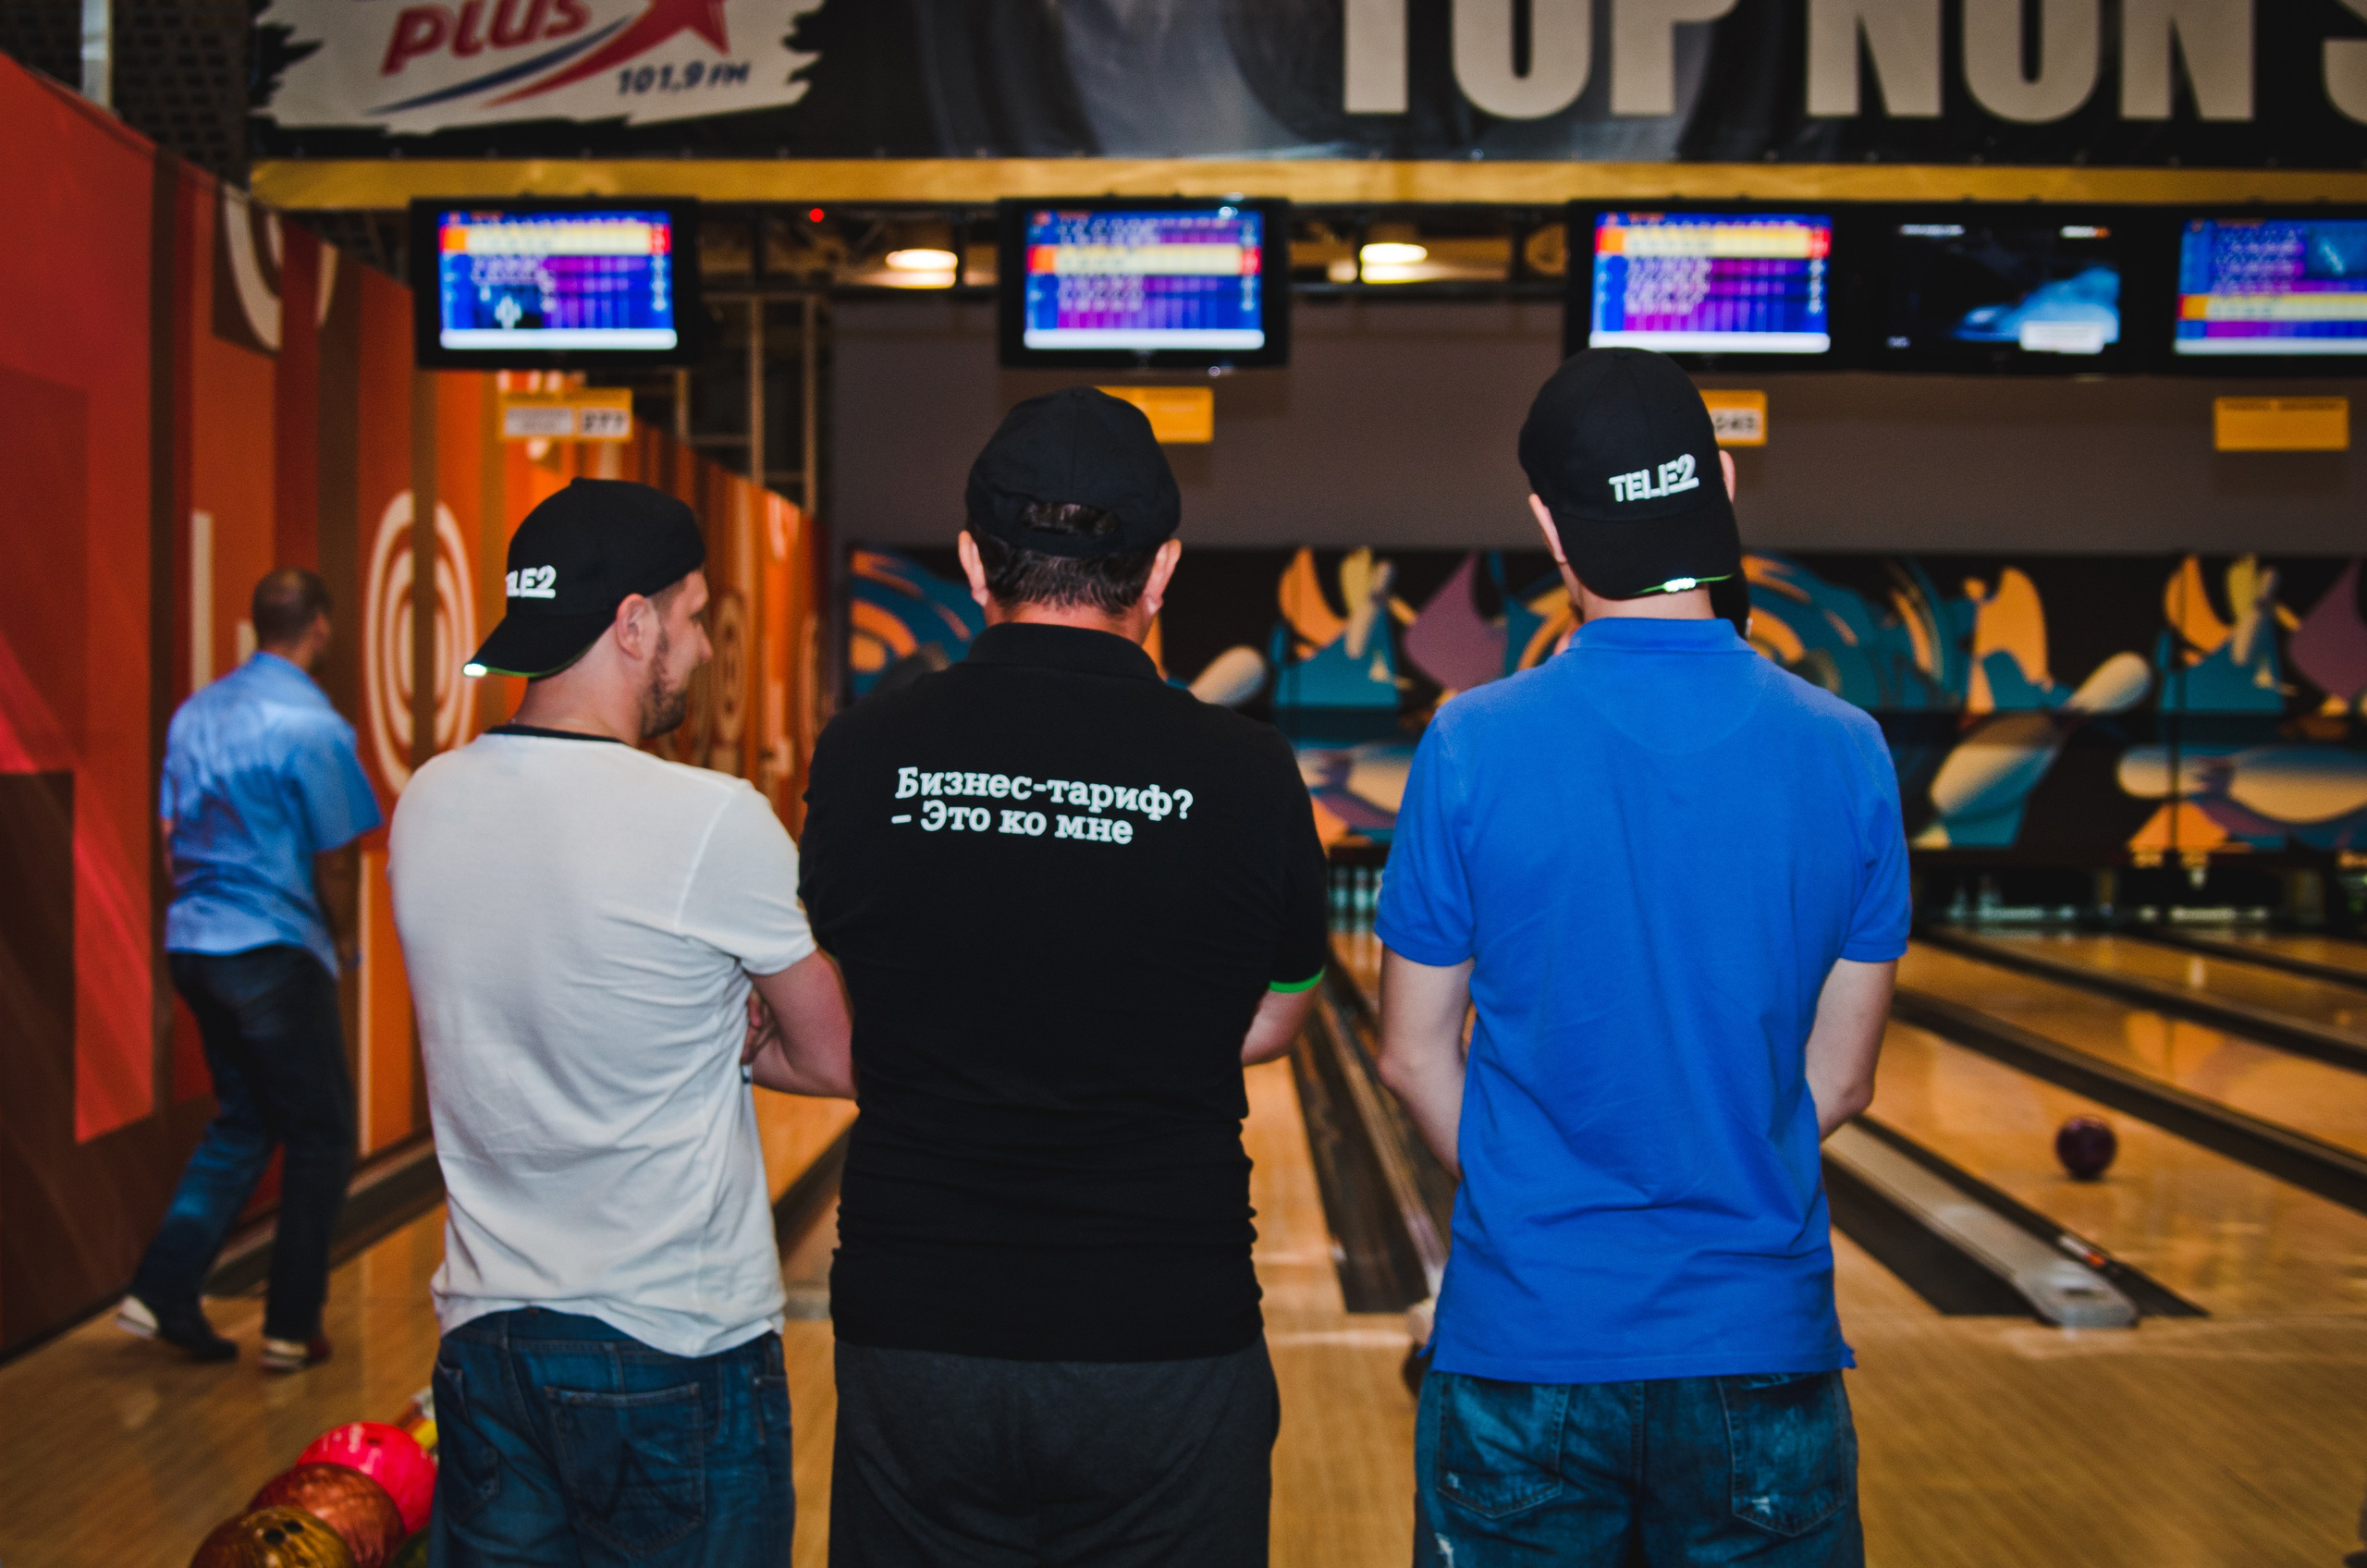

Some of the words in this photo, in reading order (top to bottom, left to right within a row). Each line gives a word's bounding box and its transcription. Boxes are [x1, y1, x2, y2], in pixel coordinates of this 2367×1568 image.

[1608, 453, 1699, 502] TELE2
[895, 766, 1194, 821] Бизнес-тариф?
[920, 800, 991, 832] Это
[999, 809, 1047, 836] ко
[1054, 814, 1134, 845] мне
